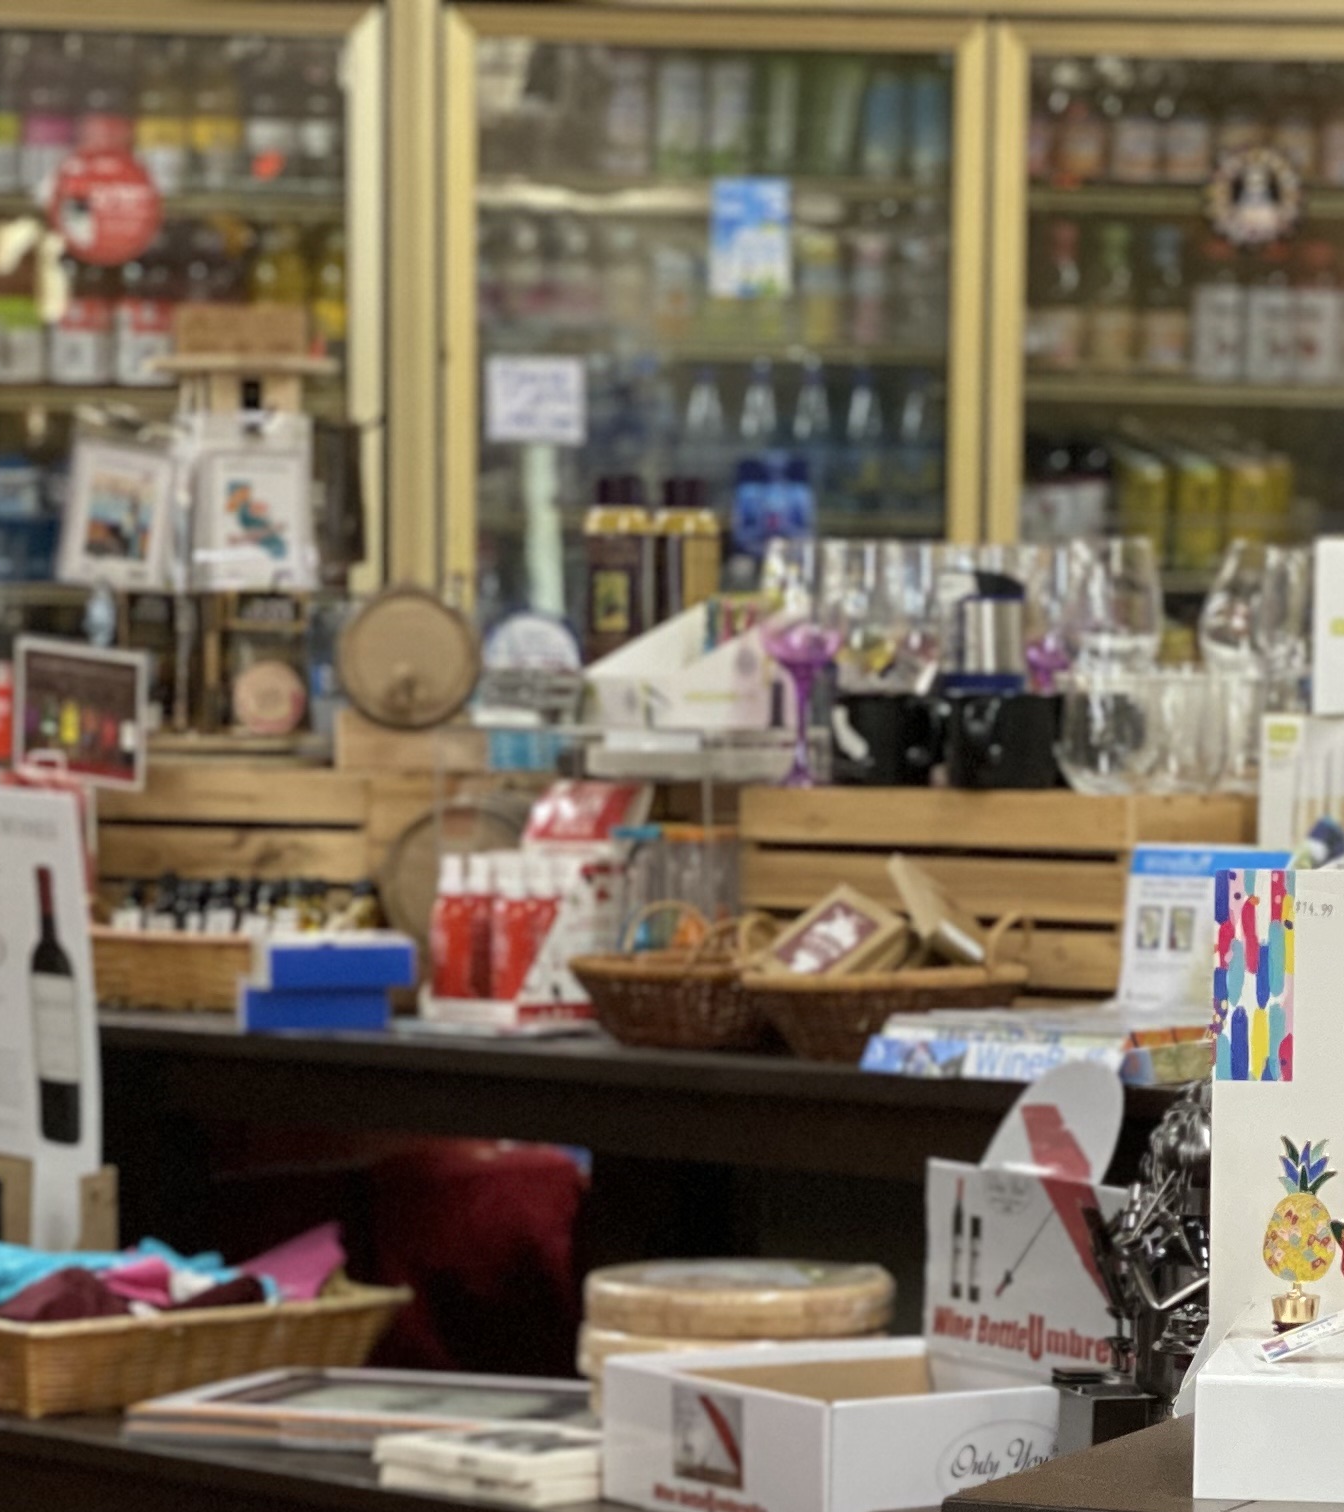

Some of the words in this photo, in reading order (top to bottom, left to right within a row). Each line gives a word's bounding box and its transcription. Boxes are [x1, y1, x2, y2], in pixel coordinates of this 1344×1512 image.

[1294, 901, 1334, 917] $14.99
[933, 1305, 974, 1341] Wine
[950, 1444, 1001, 1484] Only
